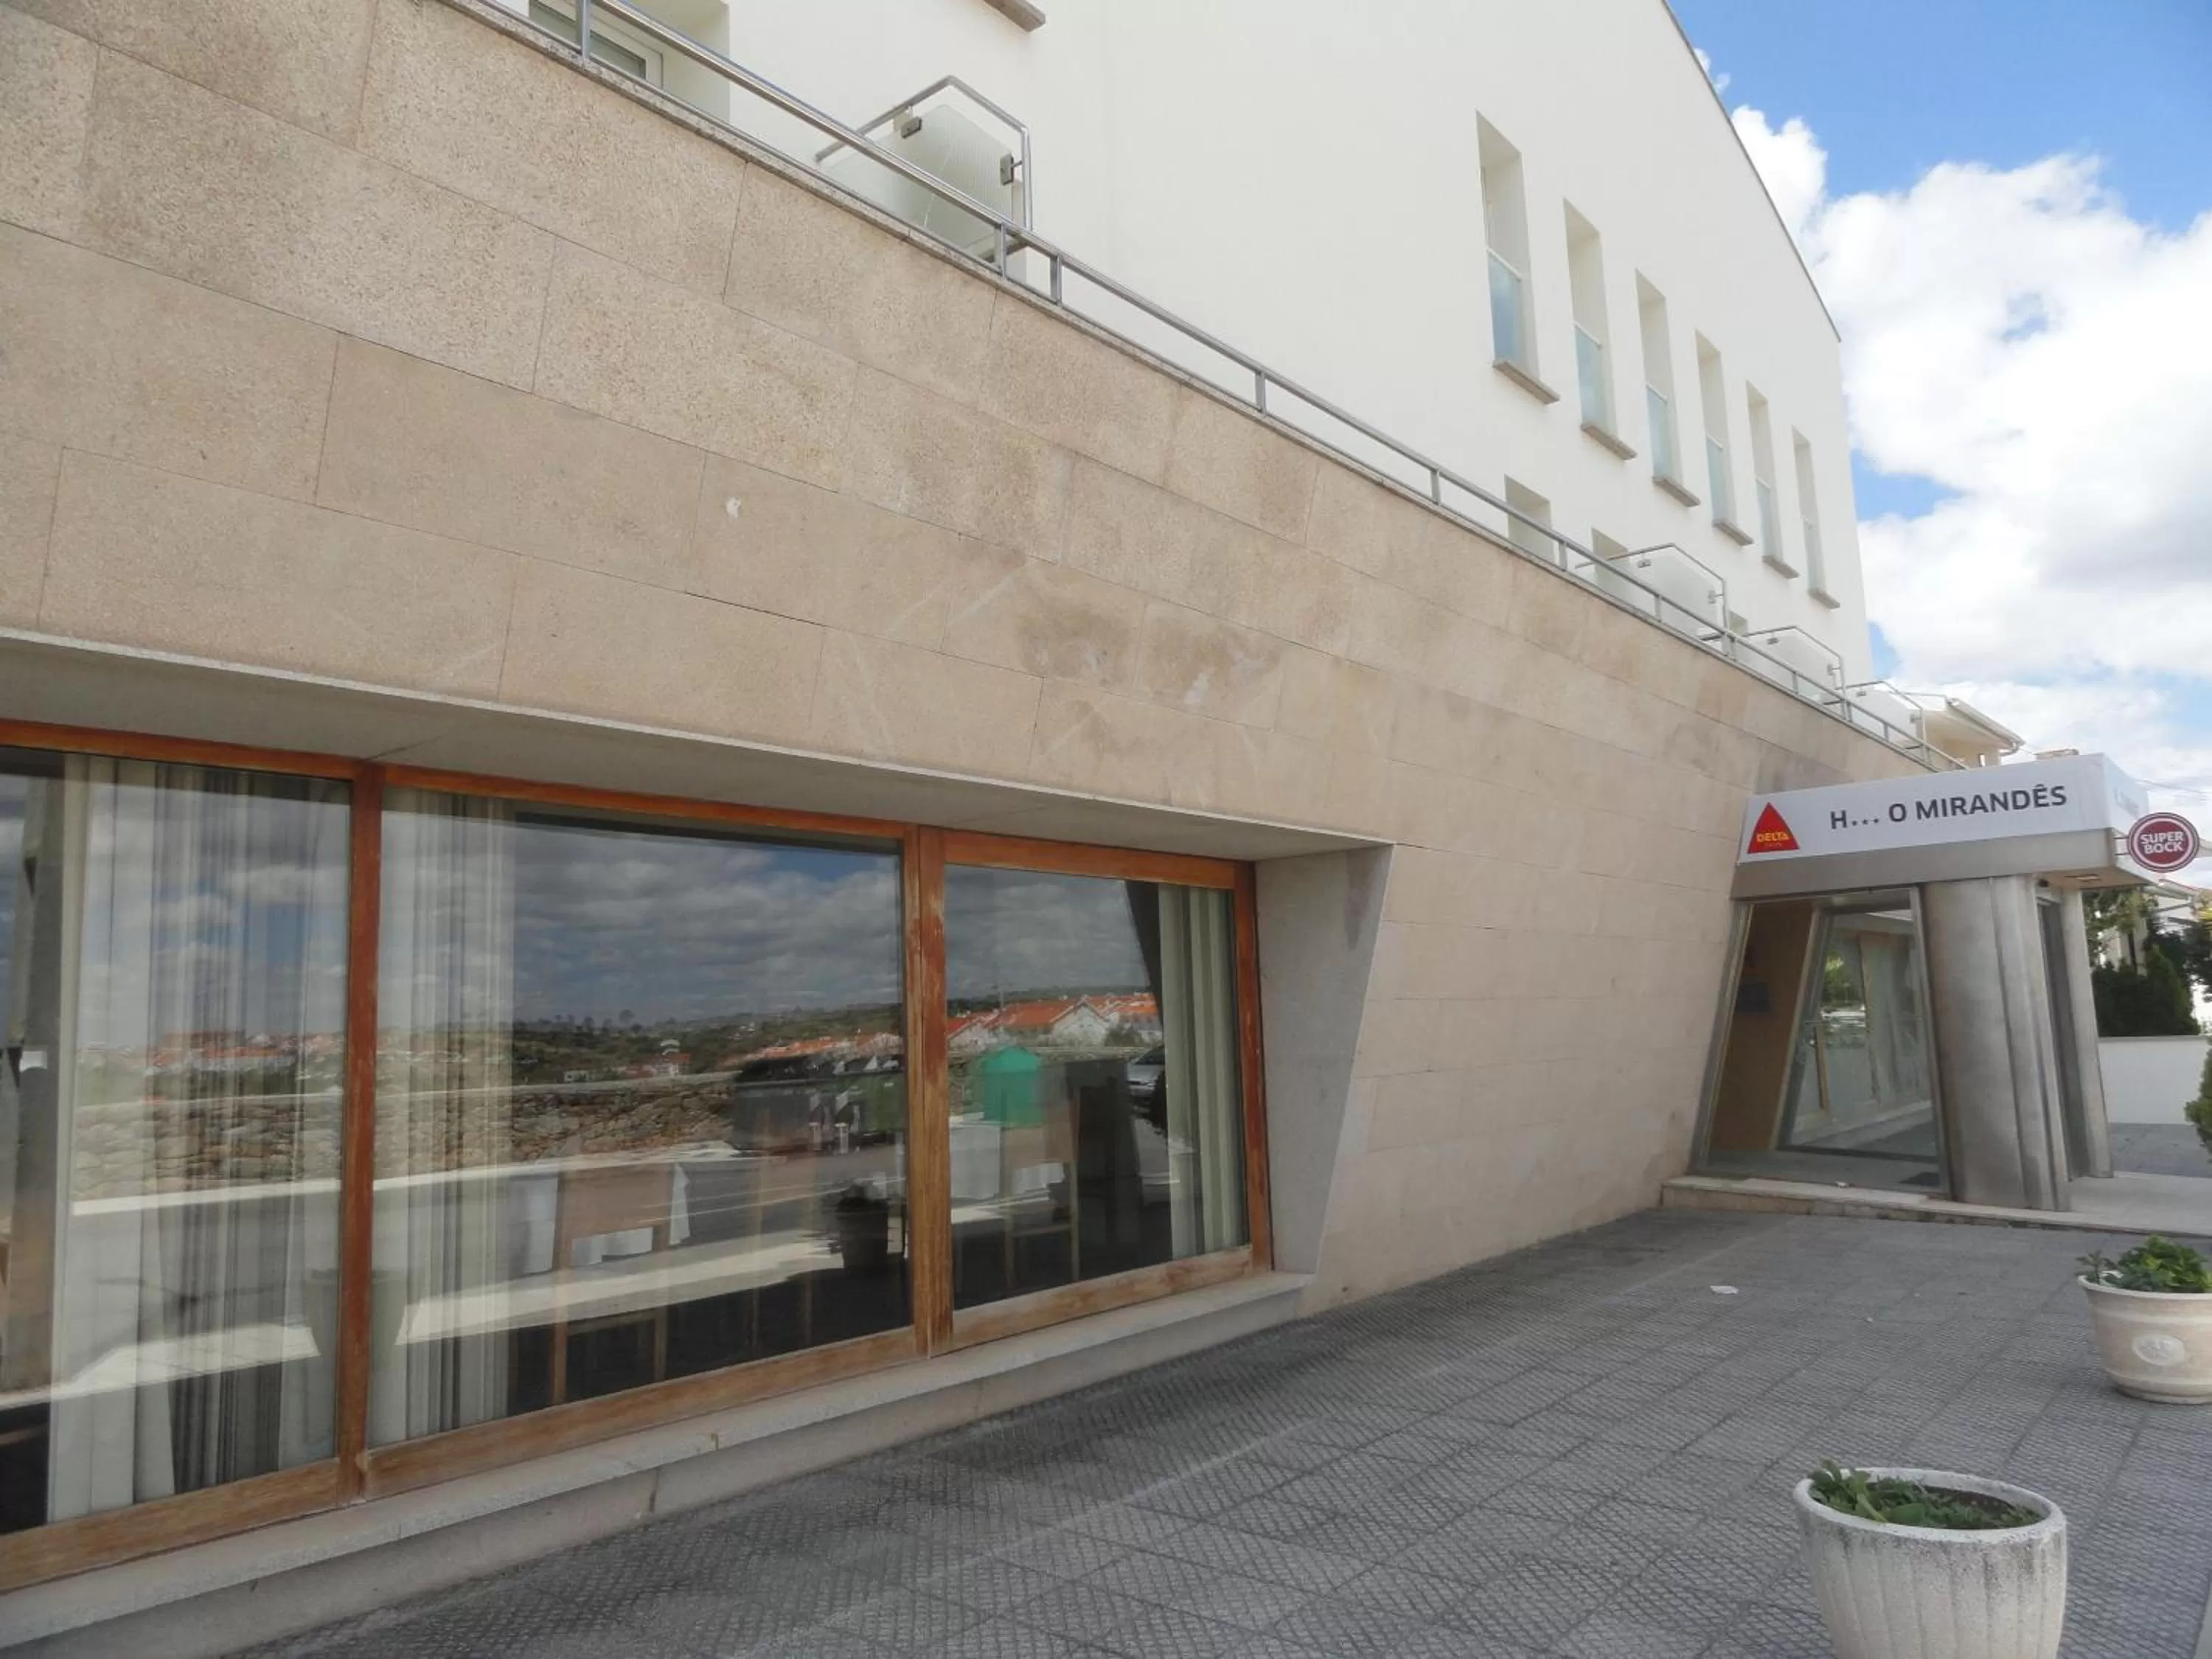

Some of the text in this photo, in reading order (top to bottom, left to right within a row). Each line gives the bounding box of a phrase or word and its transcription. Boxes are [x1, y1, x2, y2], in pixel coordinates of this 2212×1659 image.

[1889, 803, 1907, 822] O
[1915, 784, 2067, 820] MIRANDÊS
[1757, 832, 1790, 843] DELTA
[2140, 831, 2184, 844] SUPER
[2144, 841, 2183, 855] BOCK
